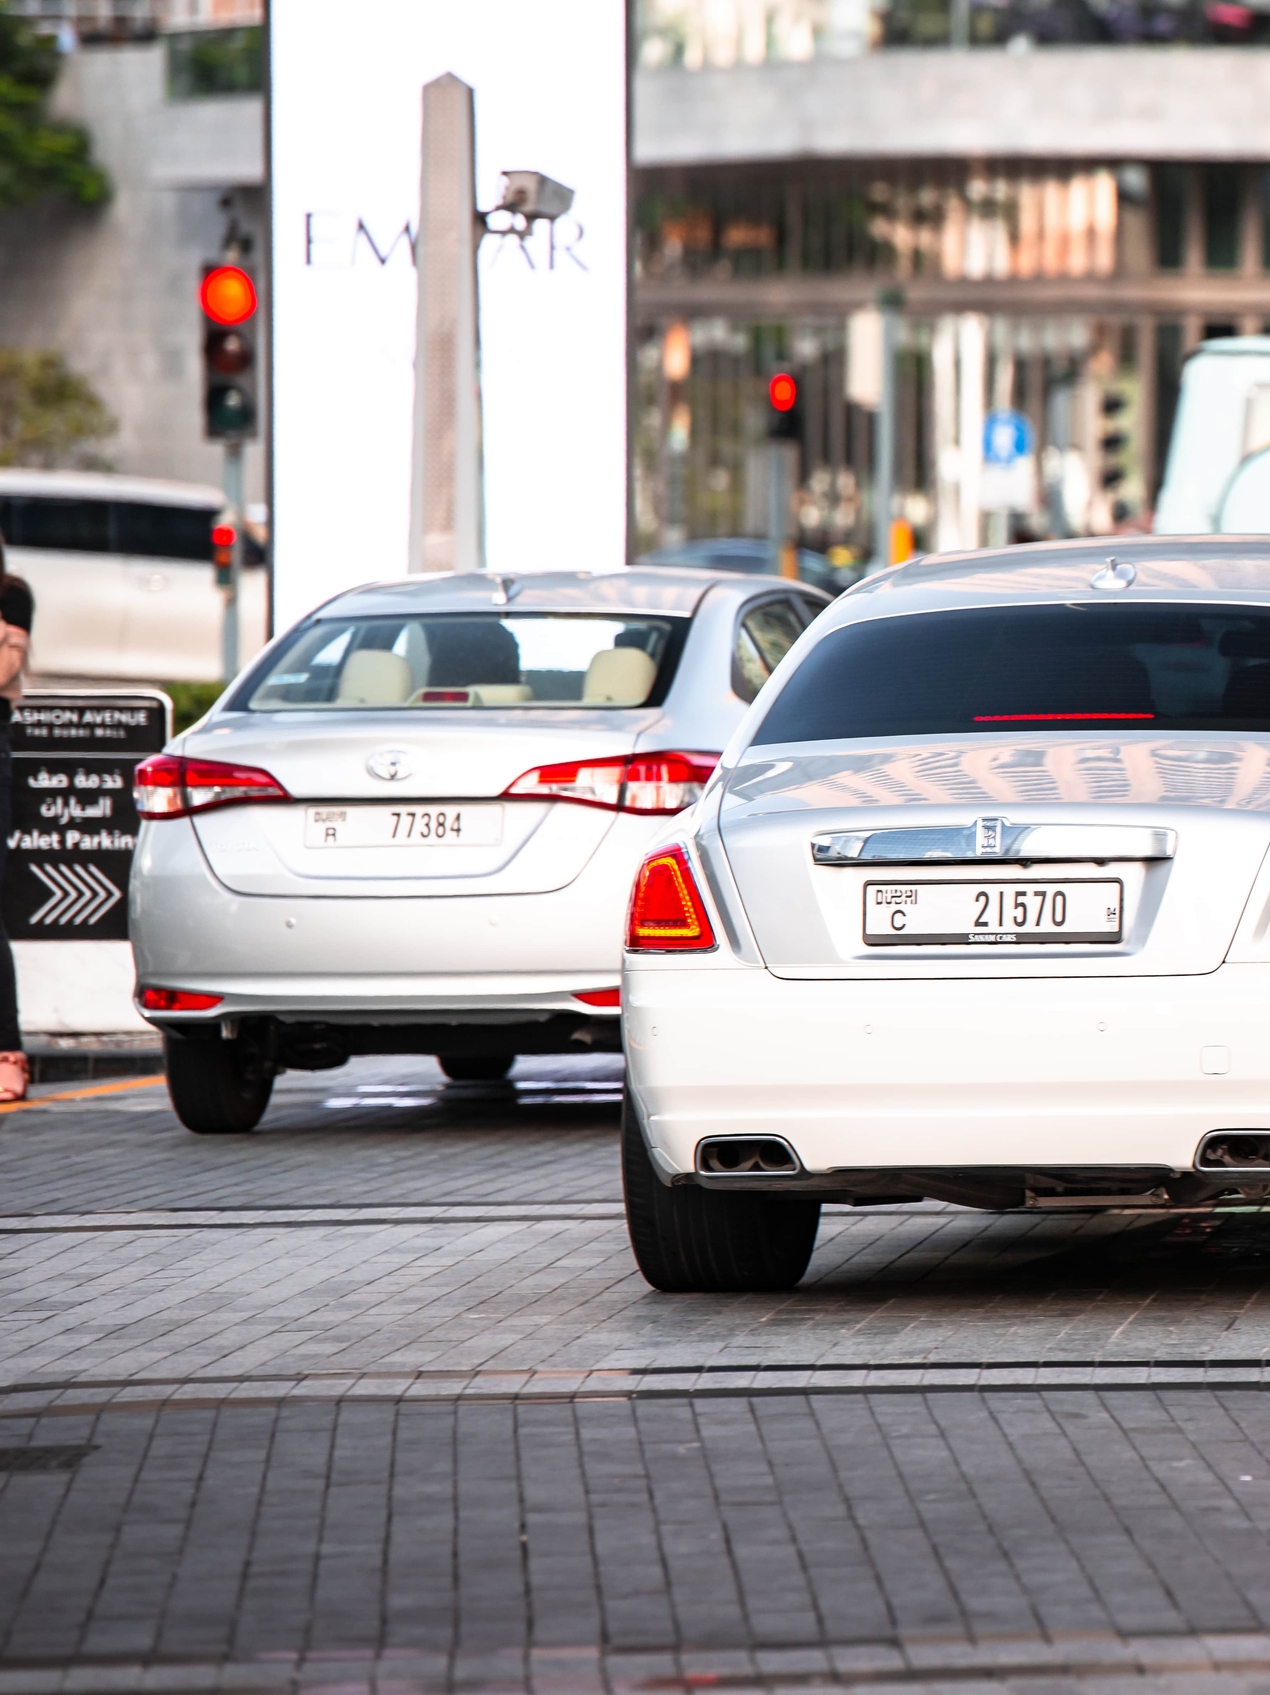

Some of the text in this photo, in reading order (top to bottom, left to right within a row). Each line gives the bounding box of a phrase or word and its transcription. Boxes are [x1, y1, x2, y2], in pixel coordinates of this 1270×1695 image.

[304, 212, 590, 271] EMAR
[10, 709, 149, 726] ASHION AVENUE
[25, 726, 127, 738] THE DUBAI MALL
[27, 766, 124, 789] خدمة صف
[40, 796, 113, 825] السيارات
[324, 827, 337, 843] R
[389, 812, 462, 839] 77384
[66, 829, 136, 850] Parkin
[974, 890, 1067, 927] 21570
[891, 909, 907, 931] C
